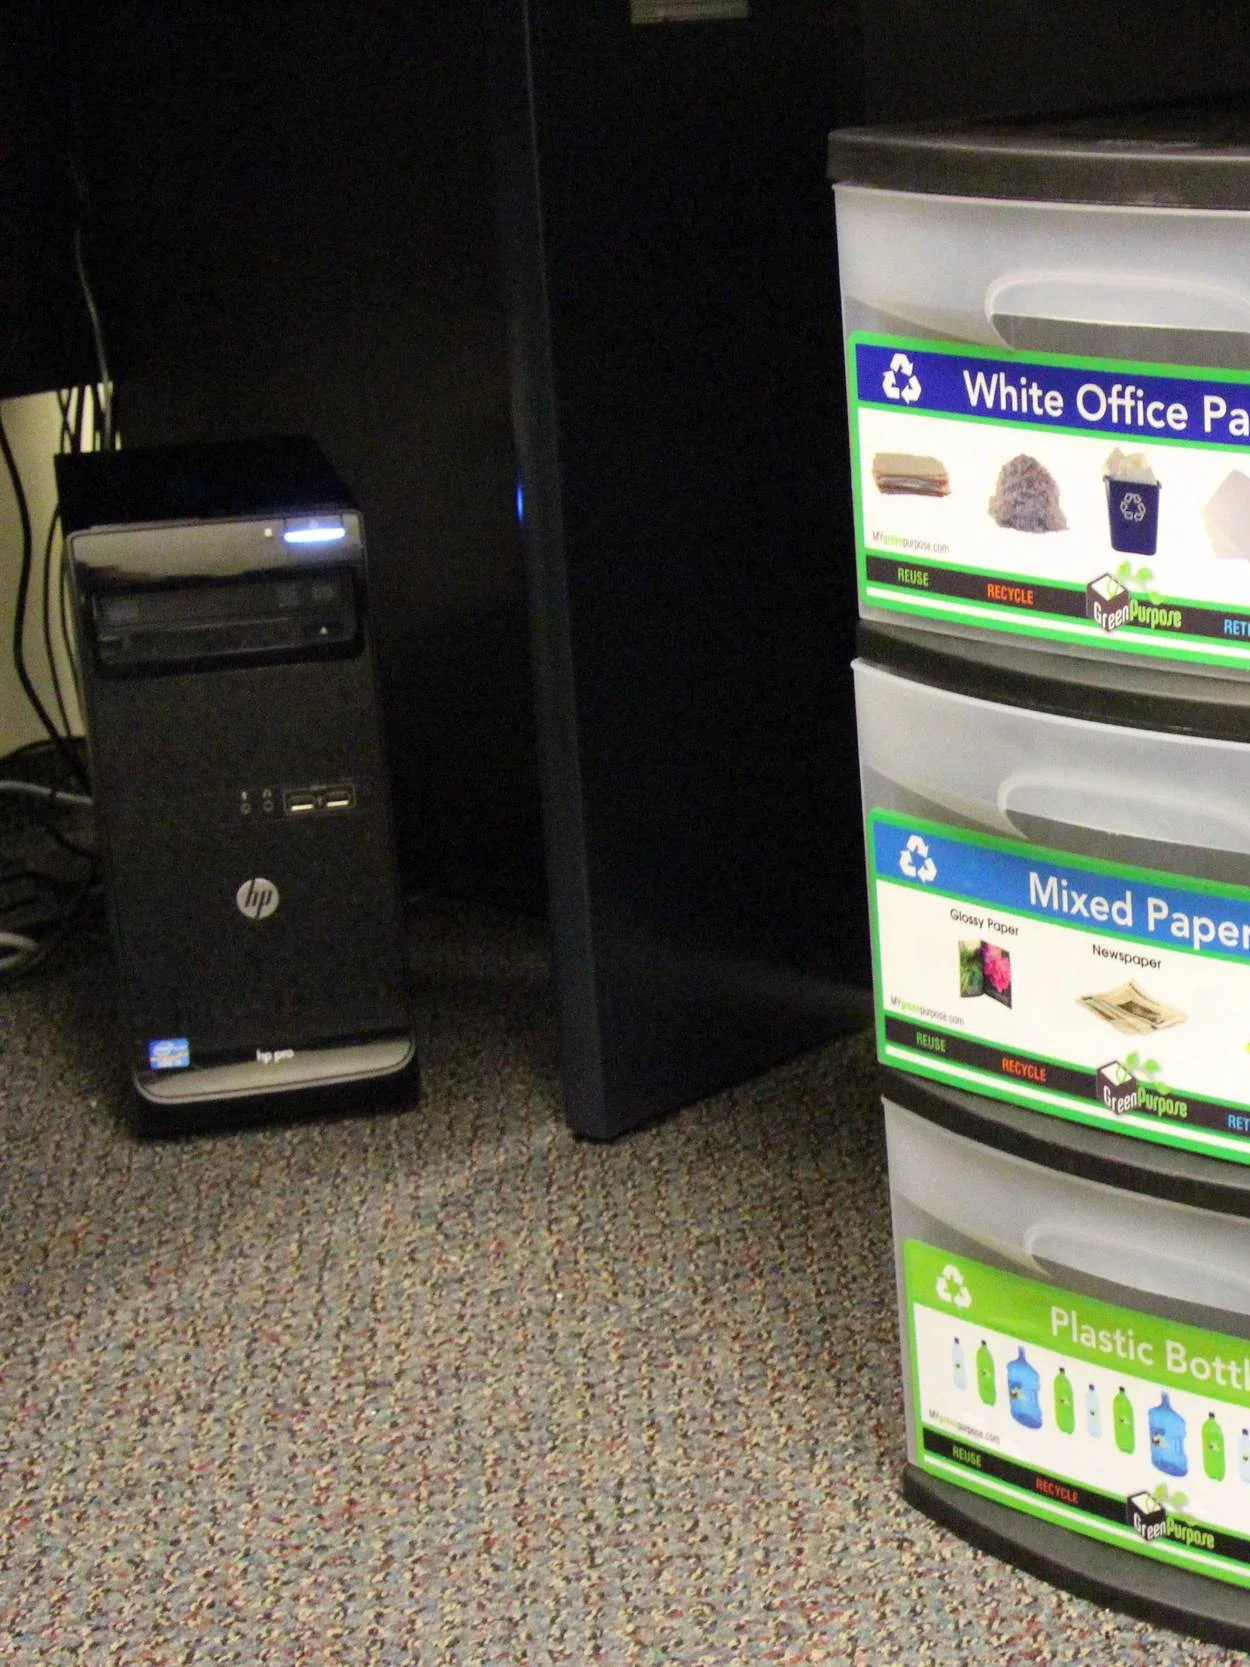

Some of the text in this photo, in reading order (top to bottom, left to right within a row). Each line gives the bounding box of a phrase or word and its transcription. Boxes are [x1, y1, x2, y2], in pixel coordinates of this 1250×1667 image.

[963, 370, 1064, 417] White
[1076, 383, 1189, 431] Office
[897, 567, 929, 587] REUSE
[987, 583, 1034, 605] RECYCLE
[243, 878, 275, 919] hp
[1028, 871, 1133, 928] Mixed
[949, 907, 1020, 936] Glossy Paper
[1091, 943, 1162, 969] Newspaper
[916, 1031, 947, 1053] REUSE
[1002, 1057, 1047, 1082] RECYCLE
[1051, 1306, 1155, 1366] Plastic
[952, 1445, 983, 1469] REUSE
[1035, 1477, 1079, 1504] RECYCLE
